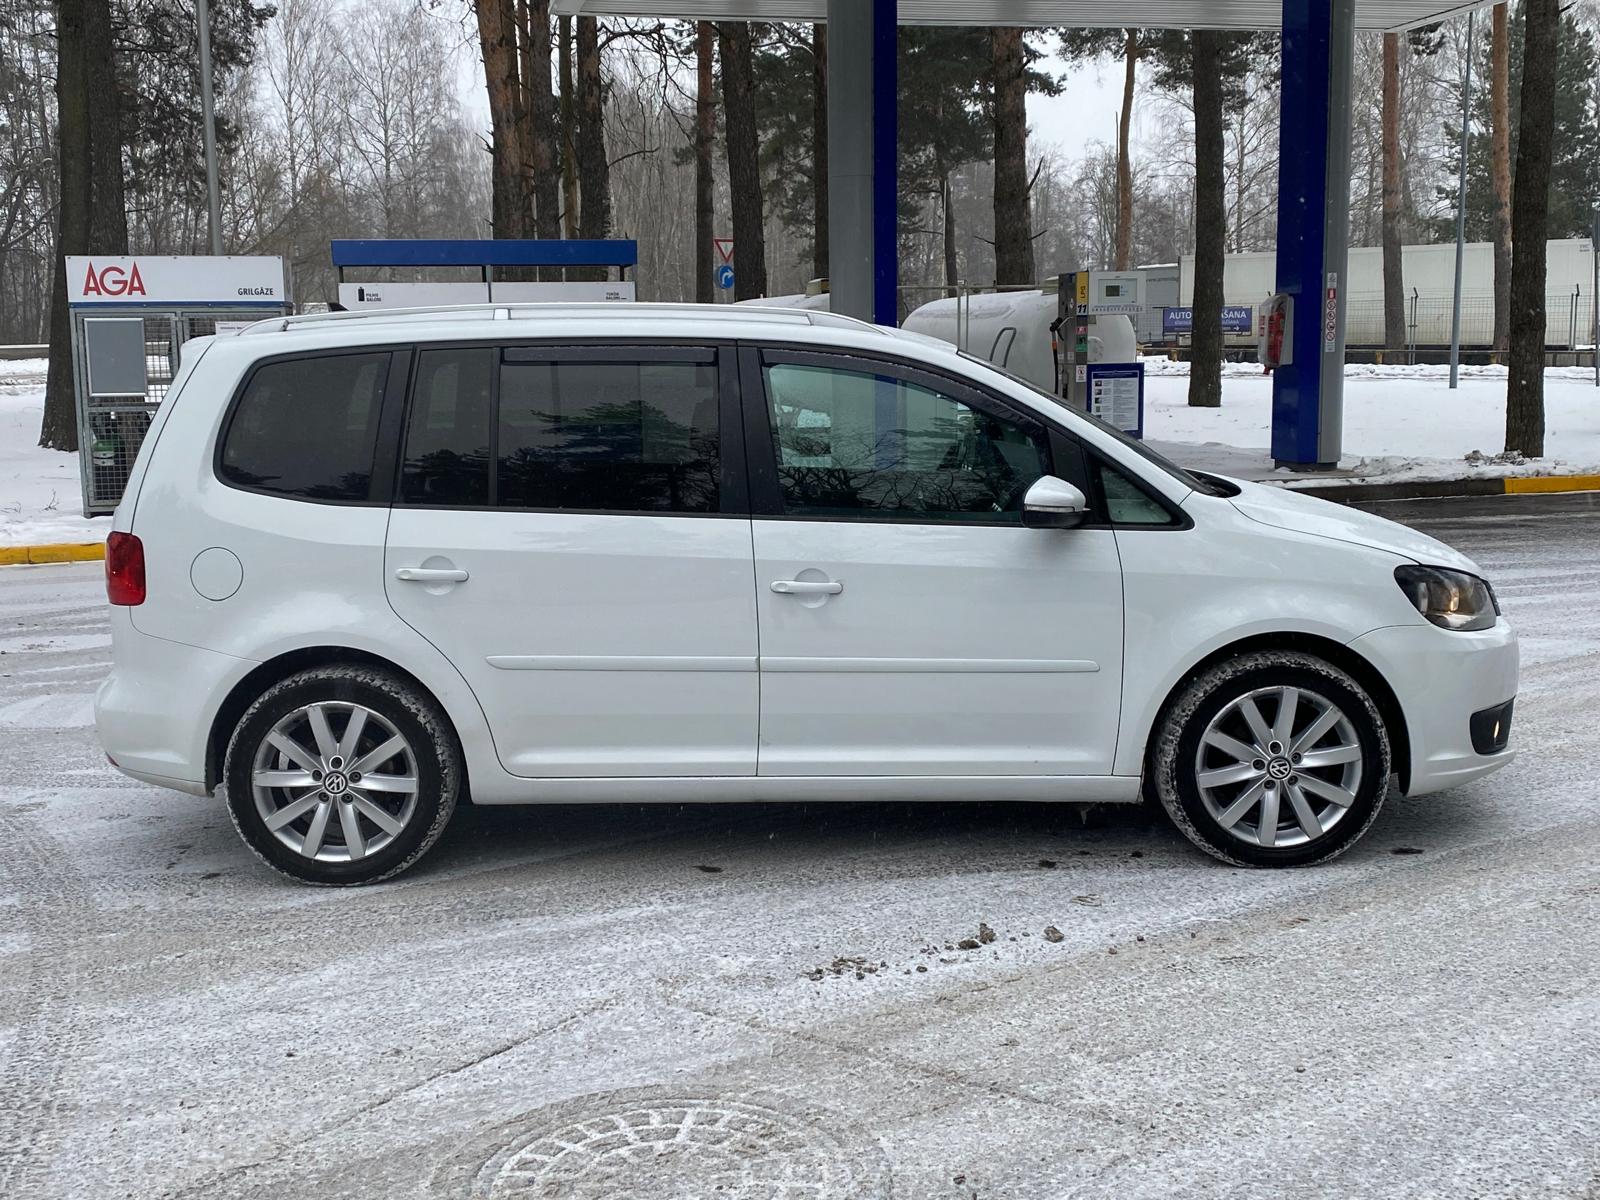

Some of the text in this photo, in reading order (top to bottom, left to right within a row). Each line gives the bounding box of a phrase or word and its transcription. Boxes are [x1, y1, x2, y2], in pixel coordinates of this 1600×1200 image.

[83, 261, 147, 296] AGA
[237, 287, 274, 296] GRILGĀZE
[1077, 304, 1087, 314] 11
